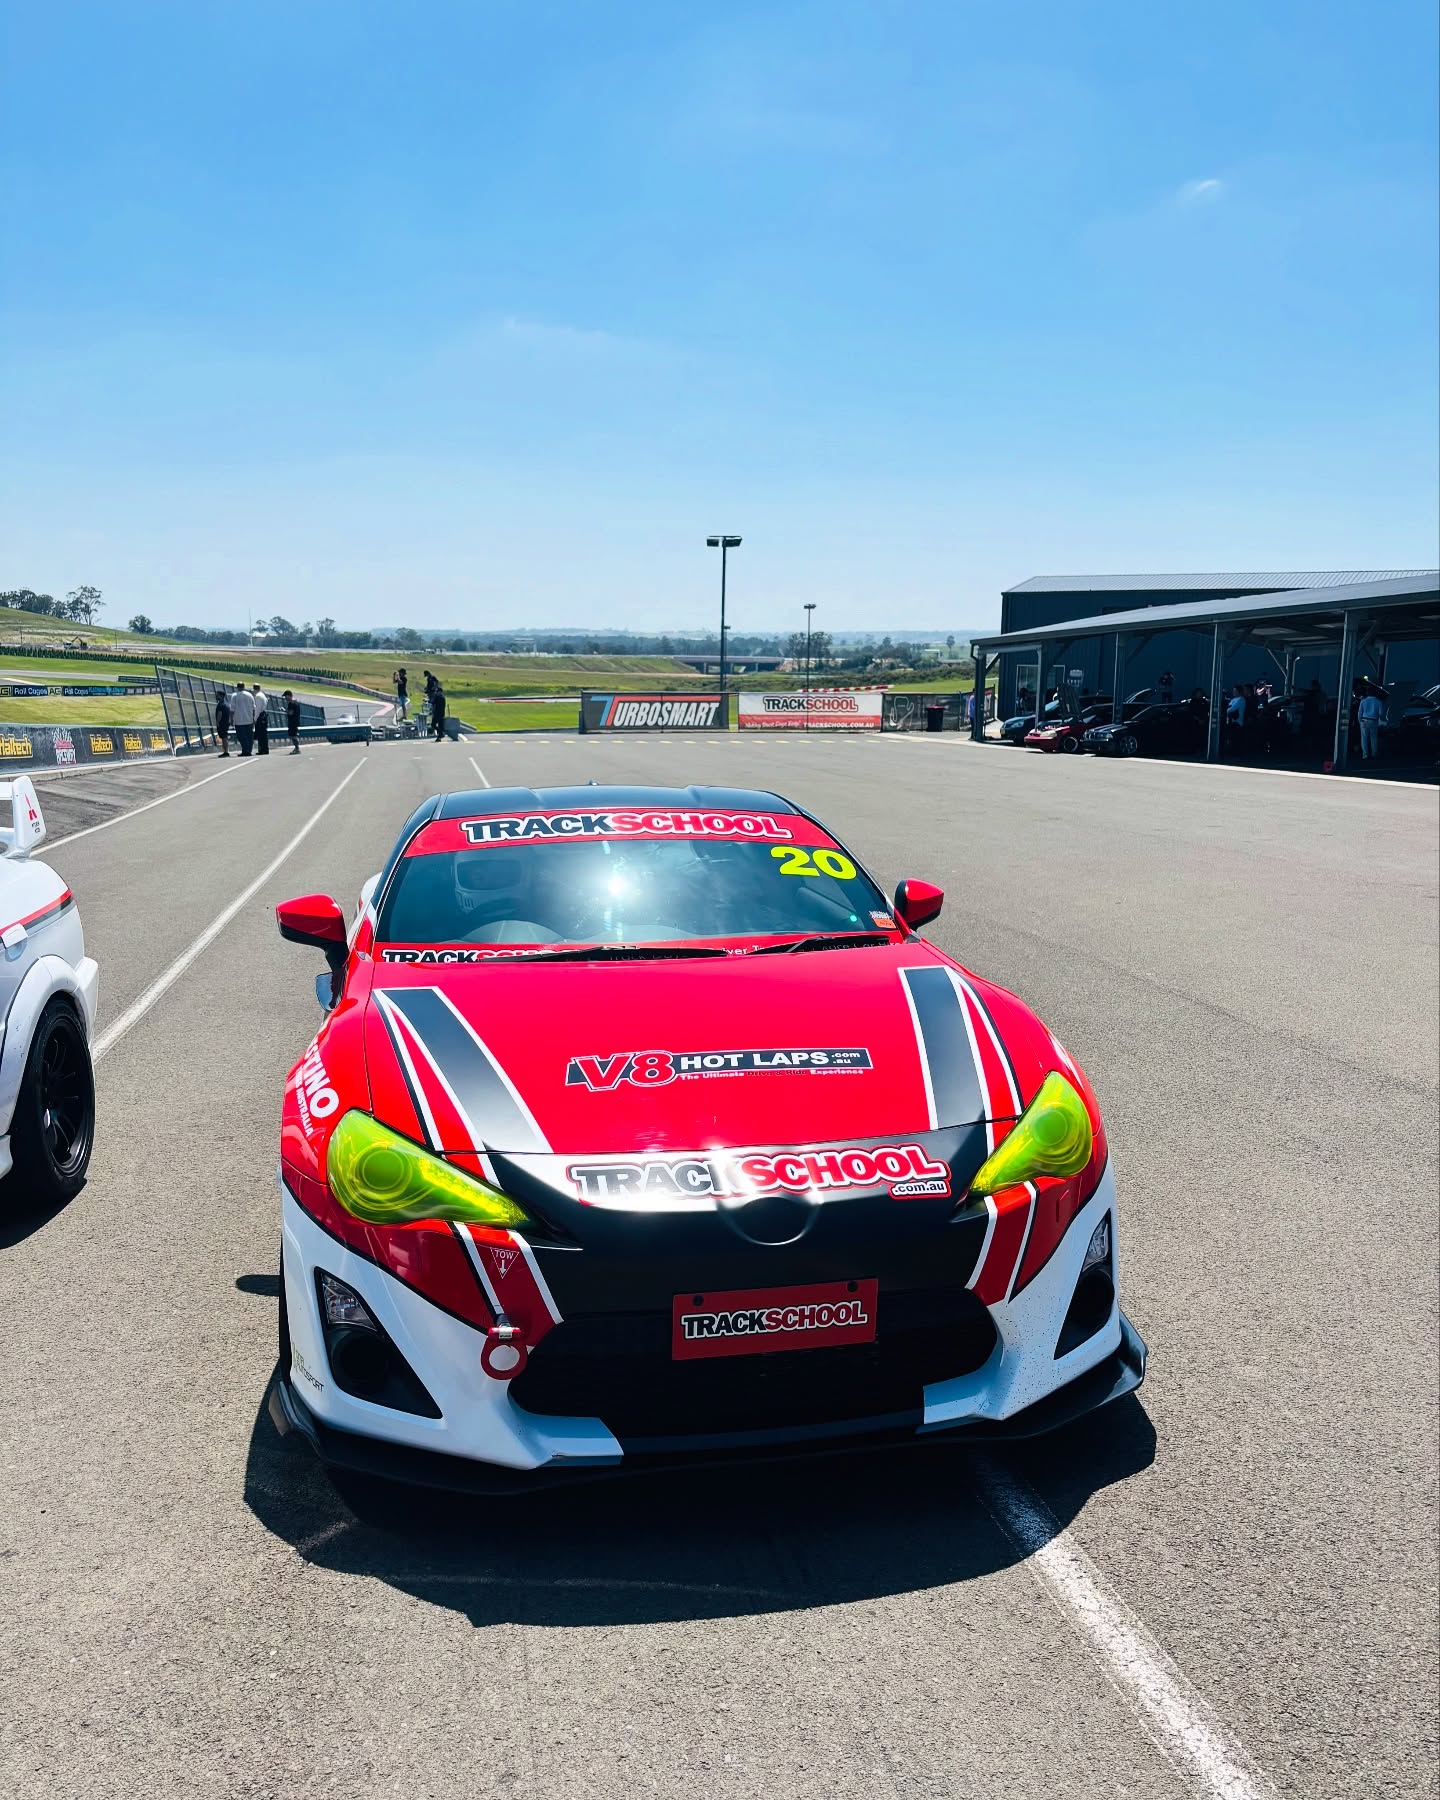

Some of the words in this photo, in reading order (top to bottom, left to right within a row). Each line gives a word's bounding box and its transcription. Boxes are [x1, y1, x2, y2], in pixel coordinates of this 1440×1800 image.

[590, 695, 721, 727] TURBOSMART
[764, 697, 858, 711] TRACKSCHOOL
[91, 735, 113, 752] Haltech
[464, 814, 790, 841] TRACKSCHOOL
[771, 846, 856, 880] 20
[574, 1051, 676, 1090] V8
[681, 1054, 743, 1069] HOT
[754, 1051, 829, 1066] LAPS
[703, 1071, 744, 1079] Ultimate
[894, 1180, 946, 1194] .com.au
[495, 1249, 514, 1260] TOW
[682, 1302, 867, 1339] TRACKSCHOOL
